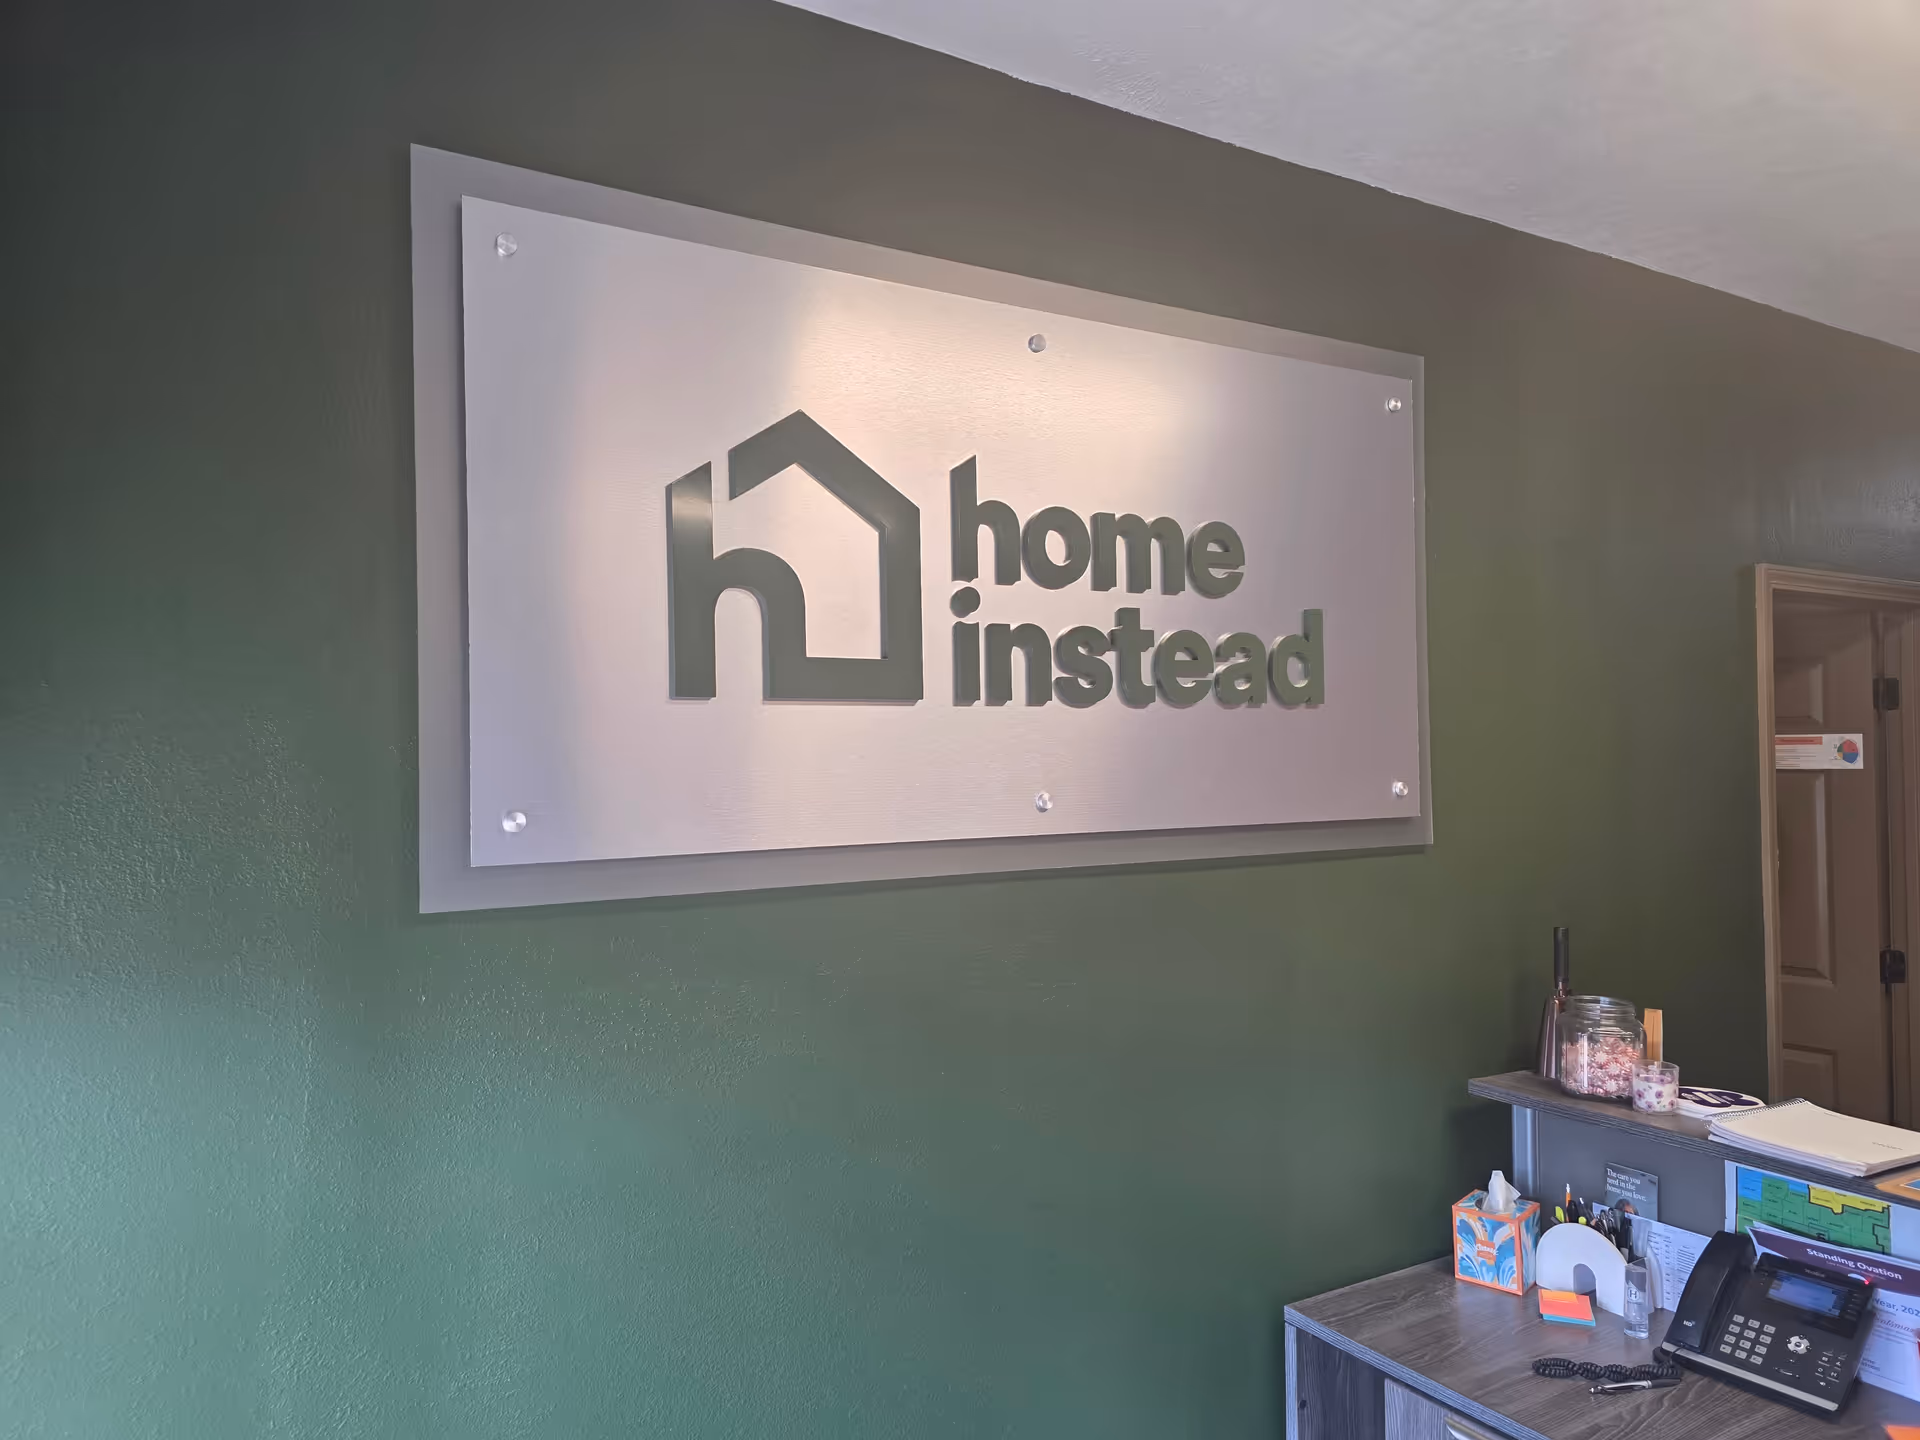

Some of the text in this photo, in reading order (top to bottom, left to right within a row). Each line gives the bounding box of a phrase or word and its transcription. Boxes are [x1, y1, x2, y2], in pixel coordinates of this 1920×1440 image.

[949, 454, 1246, 599] home
[949, 586, 1326, 708] instead
[1606, 1167, 1617, 1178] The
[1630, 1177, 1641, 1185] you
[1626, 1182, 1636, 1190] the
[1606, 1184, 1621, 1194] home
[1622, 1190, 1632, 1198] you
[1806, 1248, 1856, 1268] Standing
[1857, 1262, 1903, 1280] Ovation
